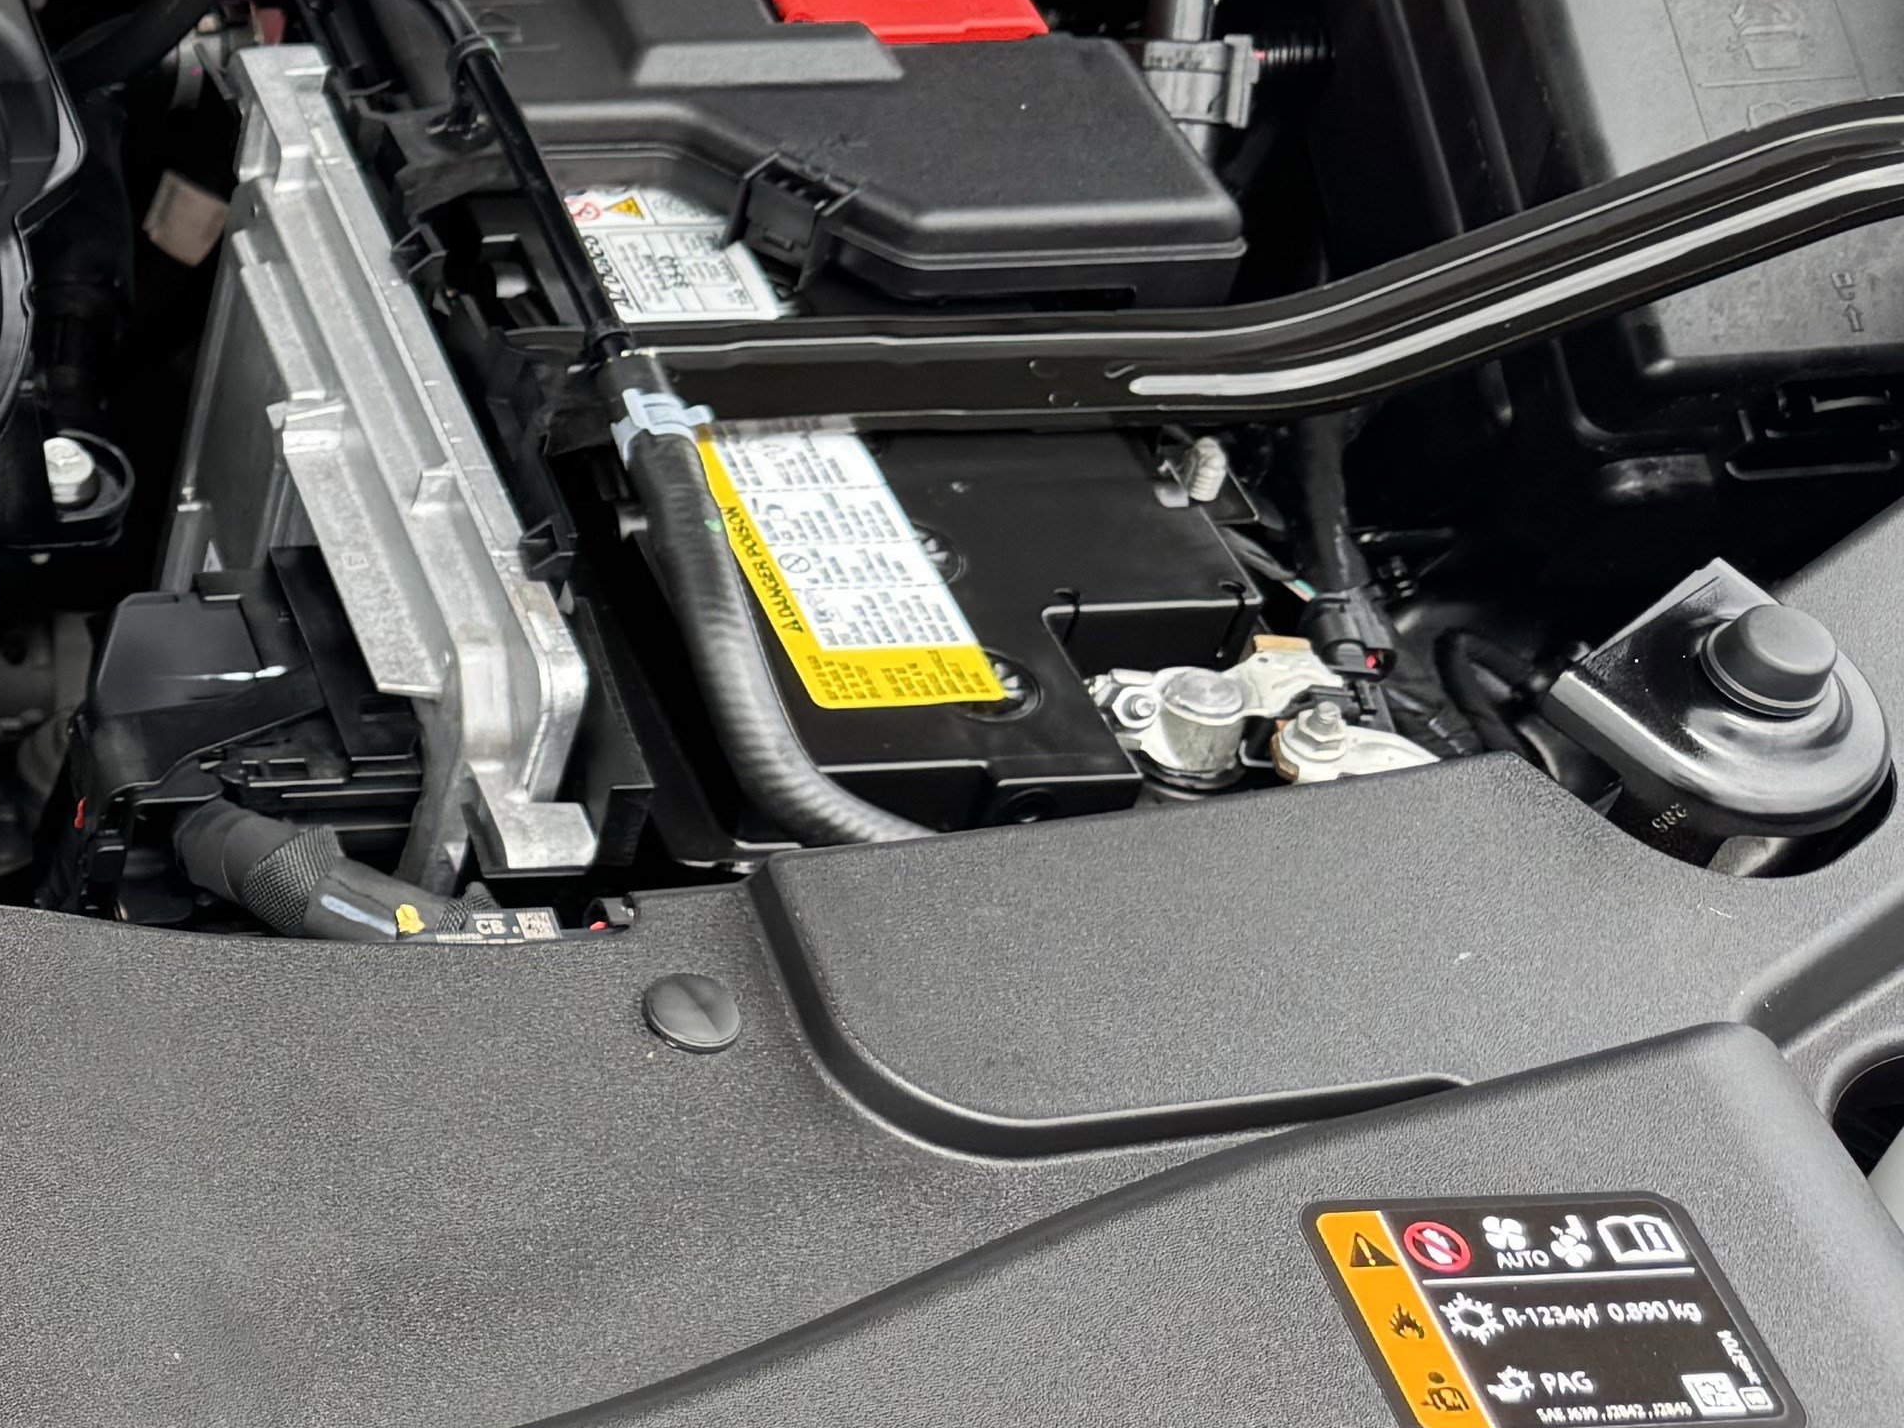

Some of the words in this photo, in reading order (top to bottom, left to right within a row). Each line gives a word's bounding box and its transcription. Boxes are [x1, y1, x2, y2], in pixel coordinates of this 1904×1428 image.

[719, 504, 765, 558] POISON
[749, 560, 797, 619] DANGER
[475, 919, 507, 935] CB
[1496, 1249, 1550, 1270] AUTO
[1501, 1301, 1600, 1329] R-1234yf
[1606, 1300, 1669, 1323] 0.890
[1667, 1298, 1703, 1323] kg
[1539, 1370, 1595, 1396] PAG
